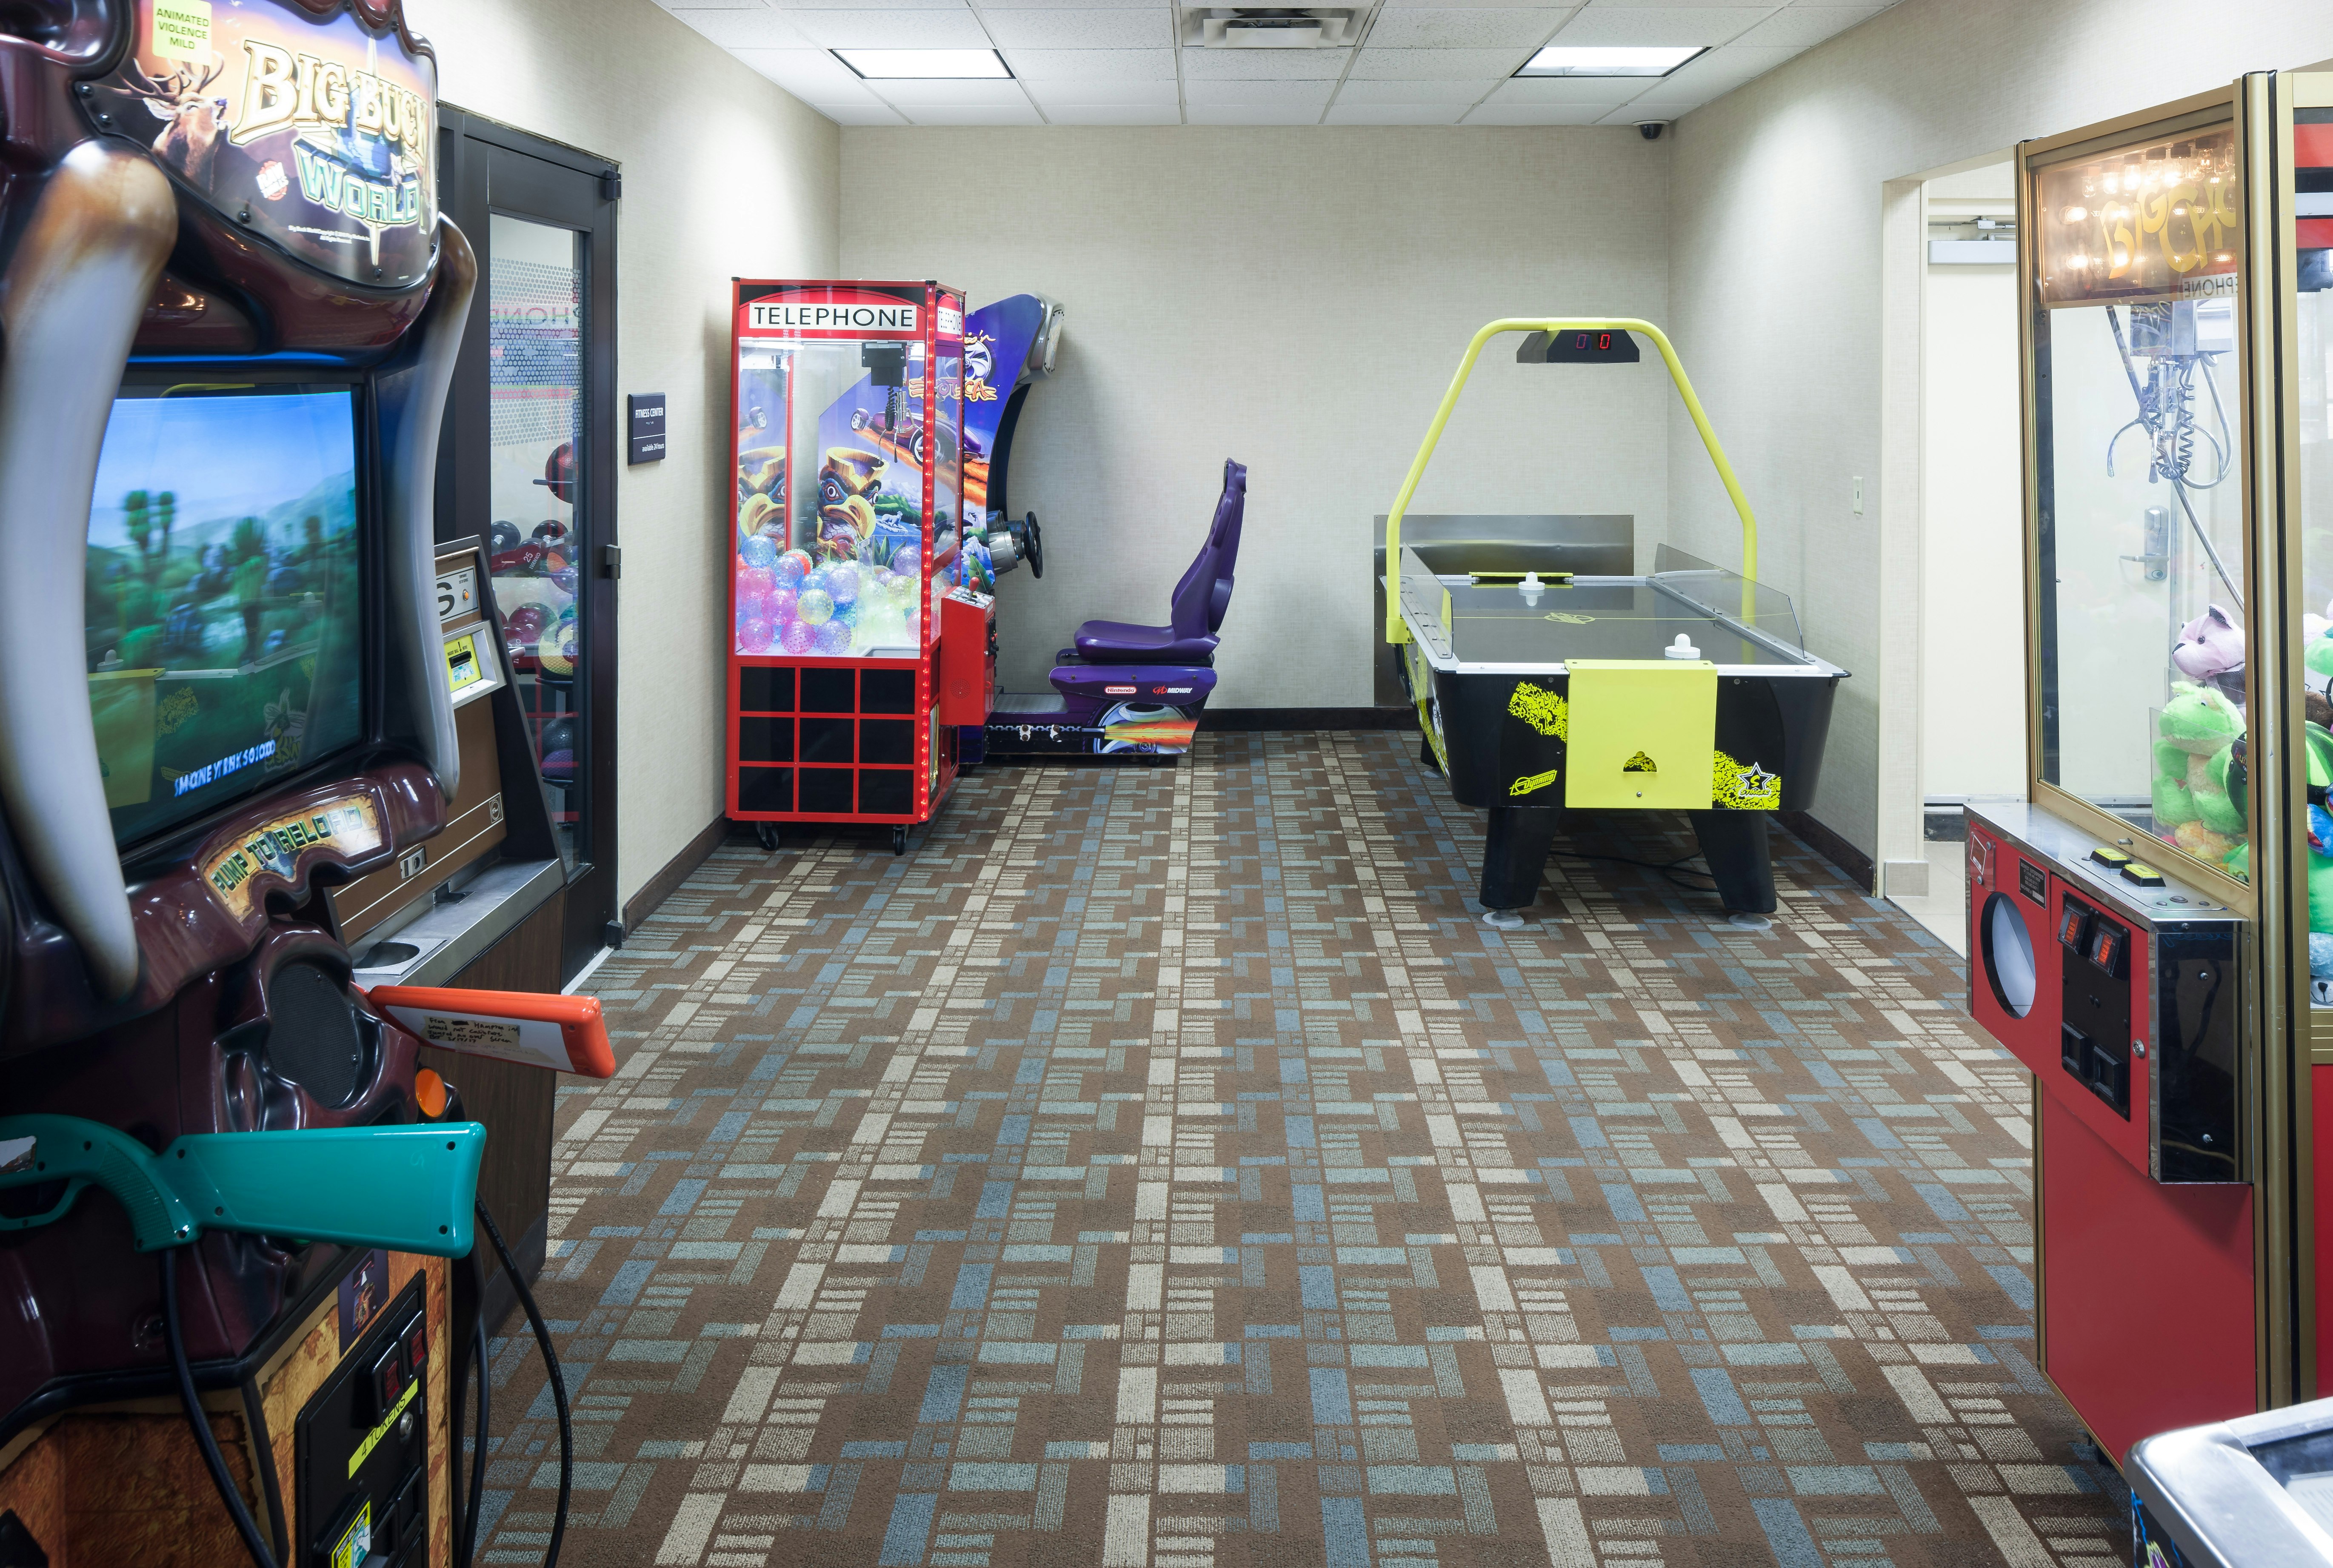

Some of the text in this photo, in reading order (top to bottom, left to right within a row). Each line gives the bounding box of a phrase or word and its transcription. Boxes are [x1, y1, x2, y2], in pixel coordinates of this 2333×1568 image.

[157, 8, 209, 27] ANIMATED
[159, 21, 207, 39] VIOLENCE
[170, 37, 195, 49] MILD
[231, 40, 428, 167] BIG BUCK
[294, 139, 420, 224] WORLD
[2099, 181, 2168, 279] BIG
[754, 307, 913, 327] TELEPHONE
[1576, 334, 1610, 348] 0 0
[635, 407, 664, 419] FITNESS CENTER
[642, 444, 654, 452] available
[523, 552, 533, 562] 25
[529, 553, 541, 570] IVANKO
[1750, 775, 1760, 787] S
[210, 805, 363, 899] PUMP TO RELOAD
[362, 1395, 406, 1457] 4 TOKENS
[336, 1537, 348, 1559] INSERT
